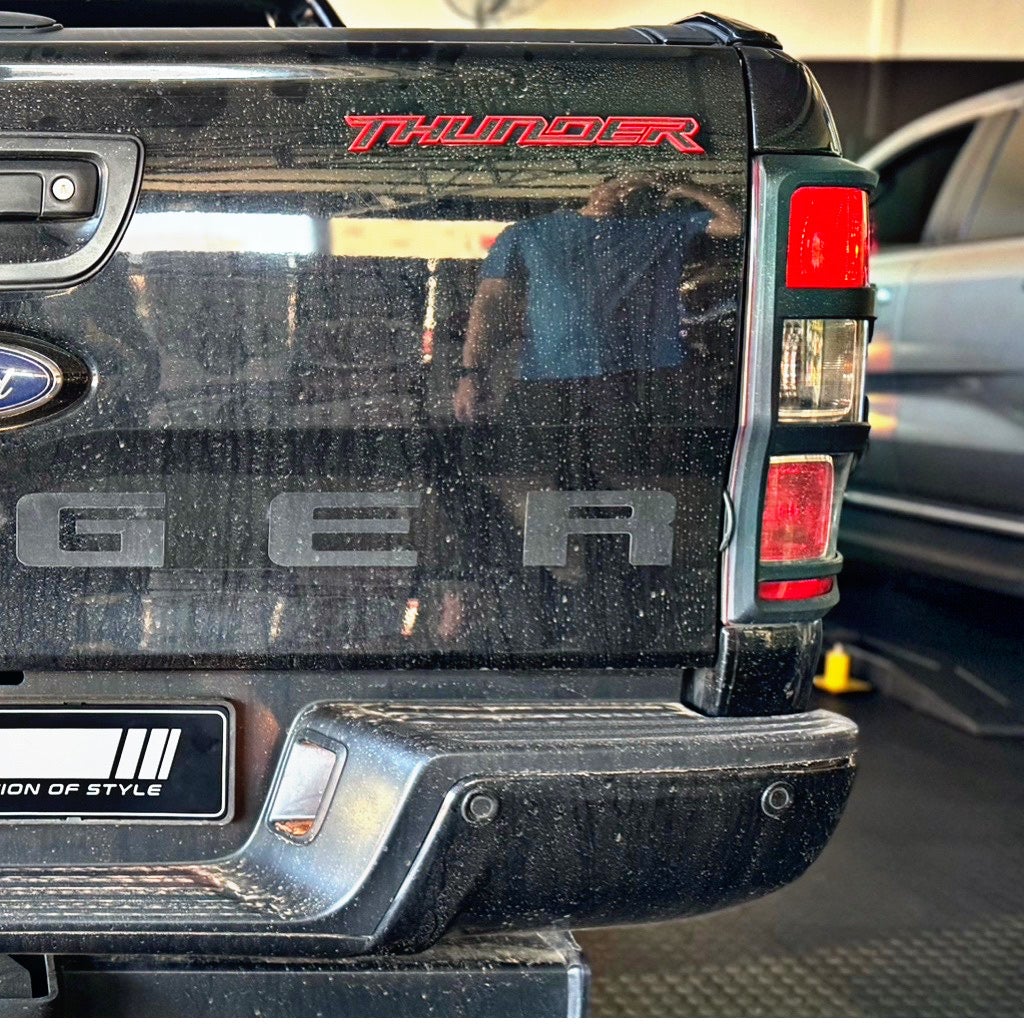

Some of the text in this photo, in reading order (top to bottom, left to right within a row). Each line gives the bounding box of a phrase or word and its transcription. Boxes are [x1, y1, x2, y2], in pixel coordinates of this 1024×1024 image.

[344, 113, 706, 155] THUNDER
[48, 783, 80, 796] OF
[86, 783, 163, 797] STYLE
